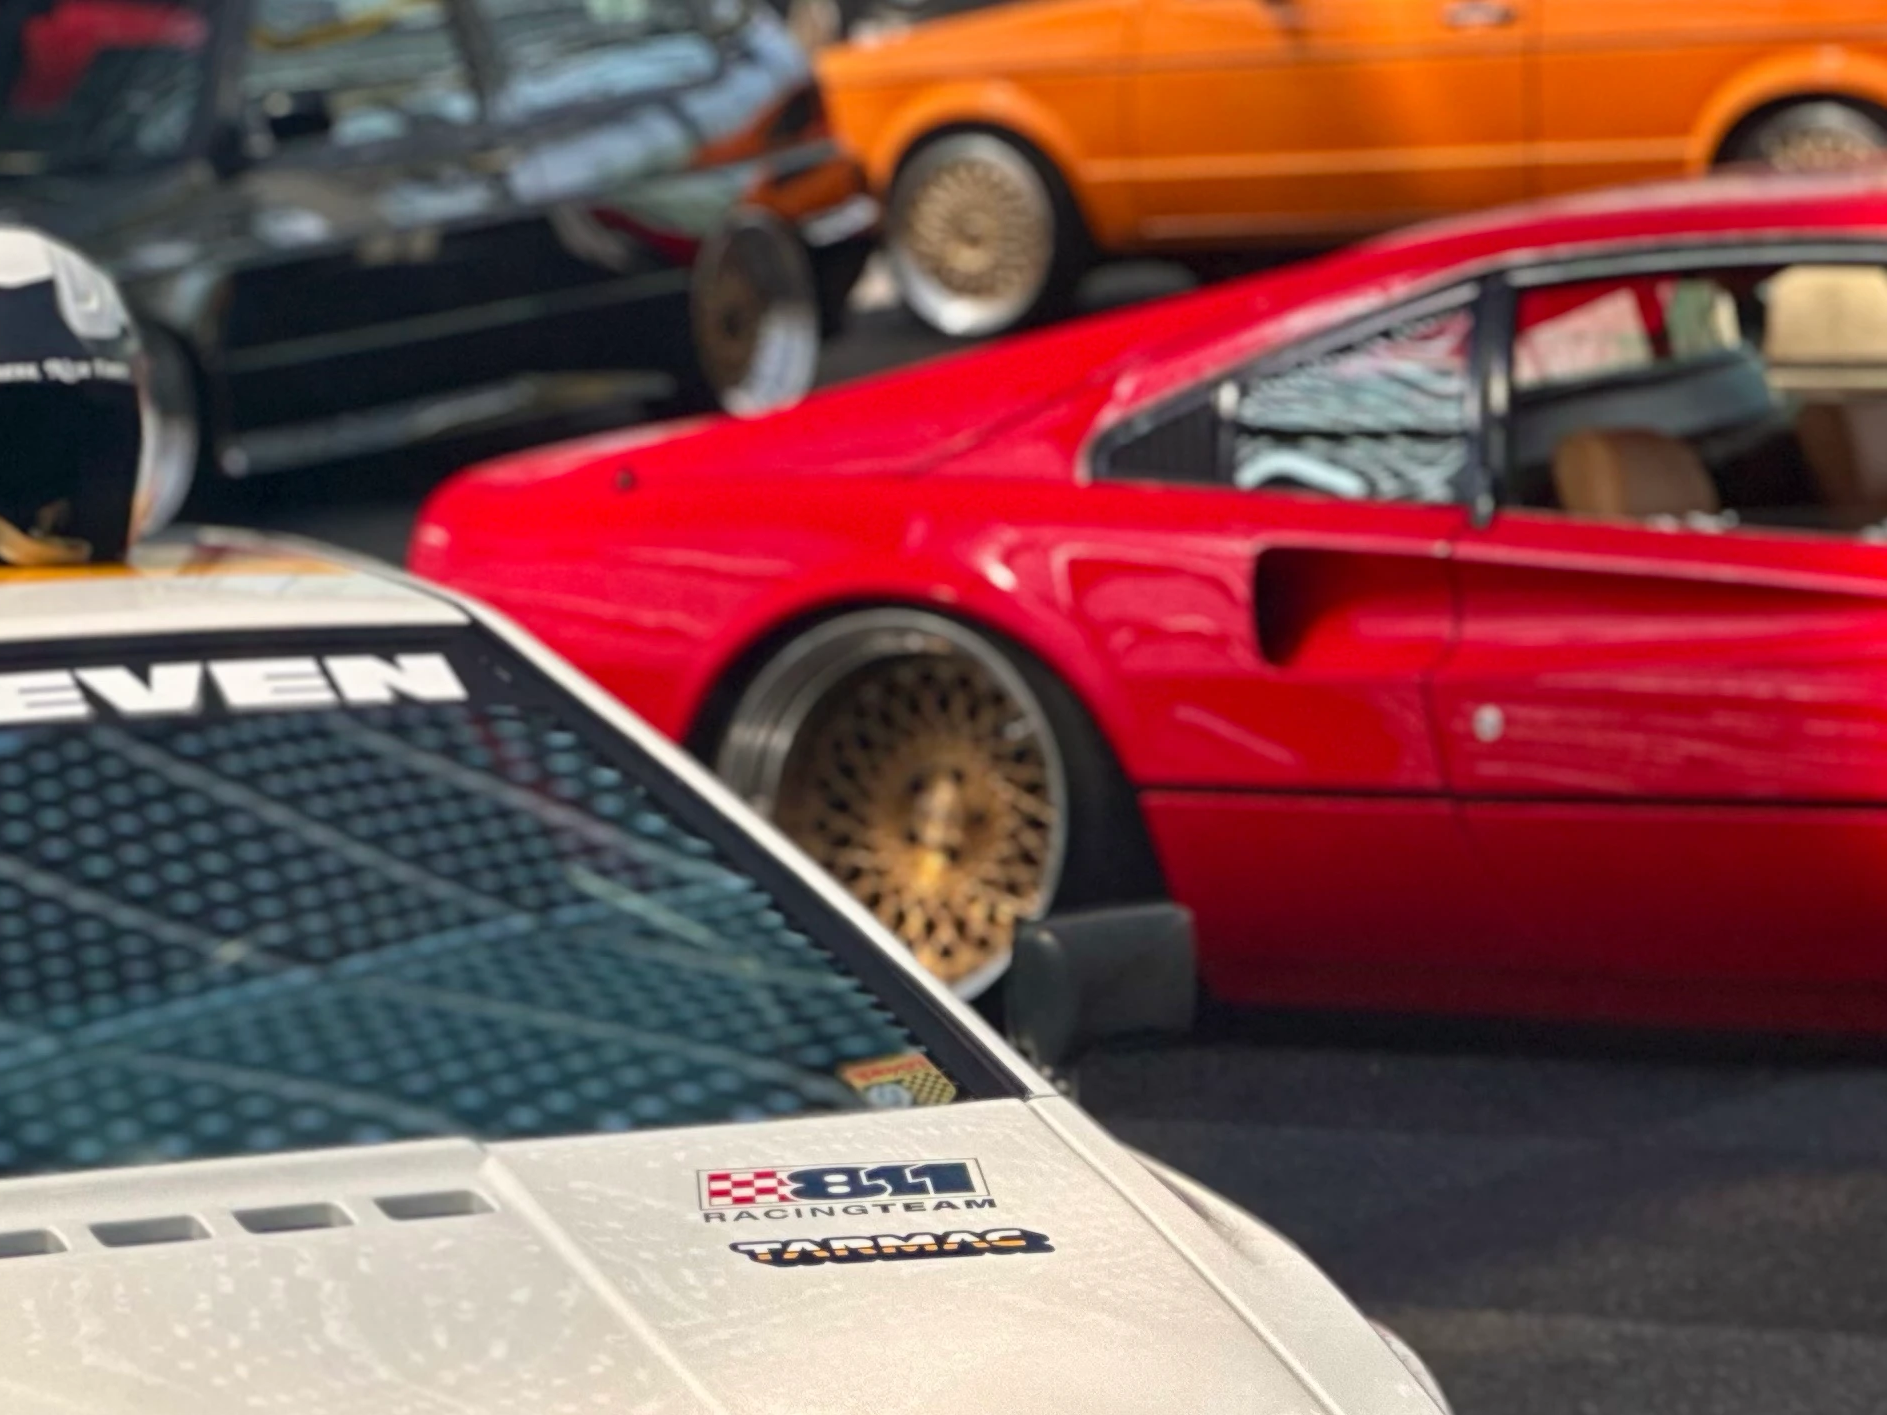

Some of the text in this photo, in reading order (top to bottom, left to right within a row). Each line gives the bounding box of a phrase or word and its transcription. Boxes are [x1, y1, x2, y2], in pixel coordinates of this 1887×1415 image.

[787, 1161, 977, 1200] 811
[703, 1198, 997, 1223] RACINGTEAM
[730, 1228, 1053, 1267] TARMAC
